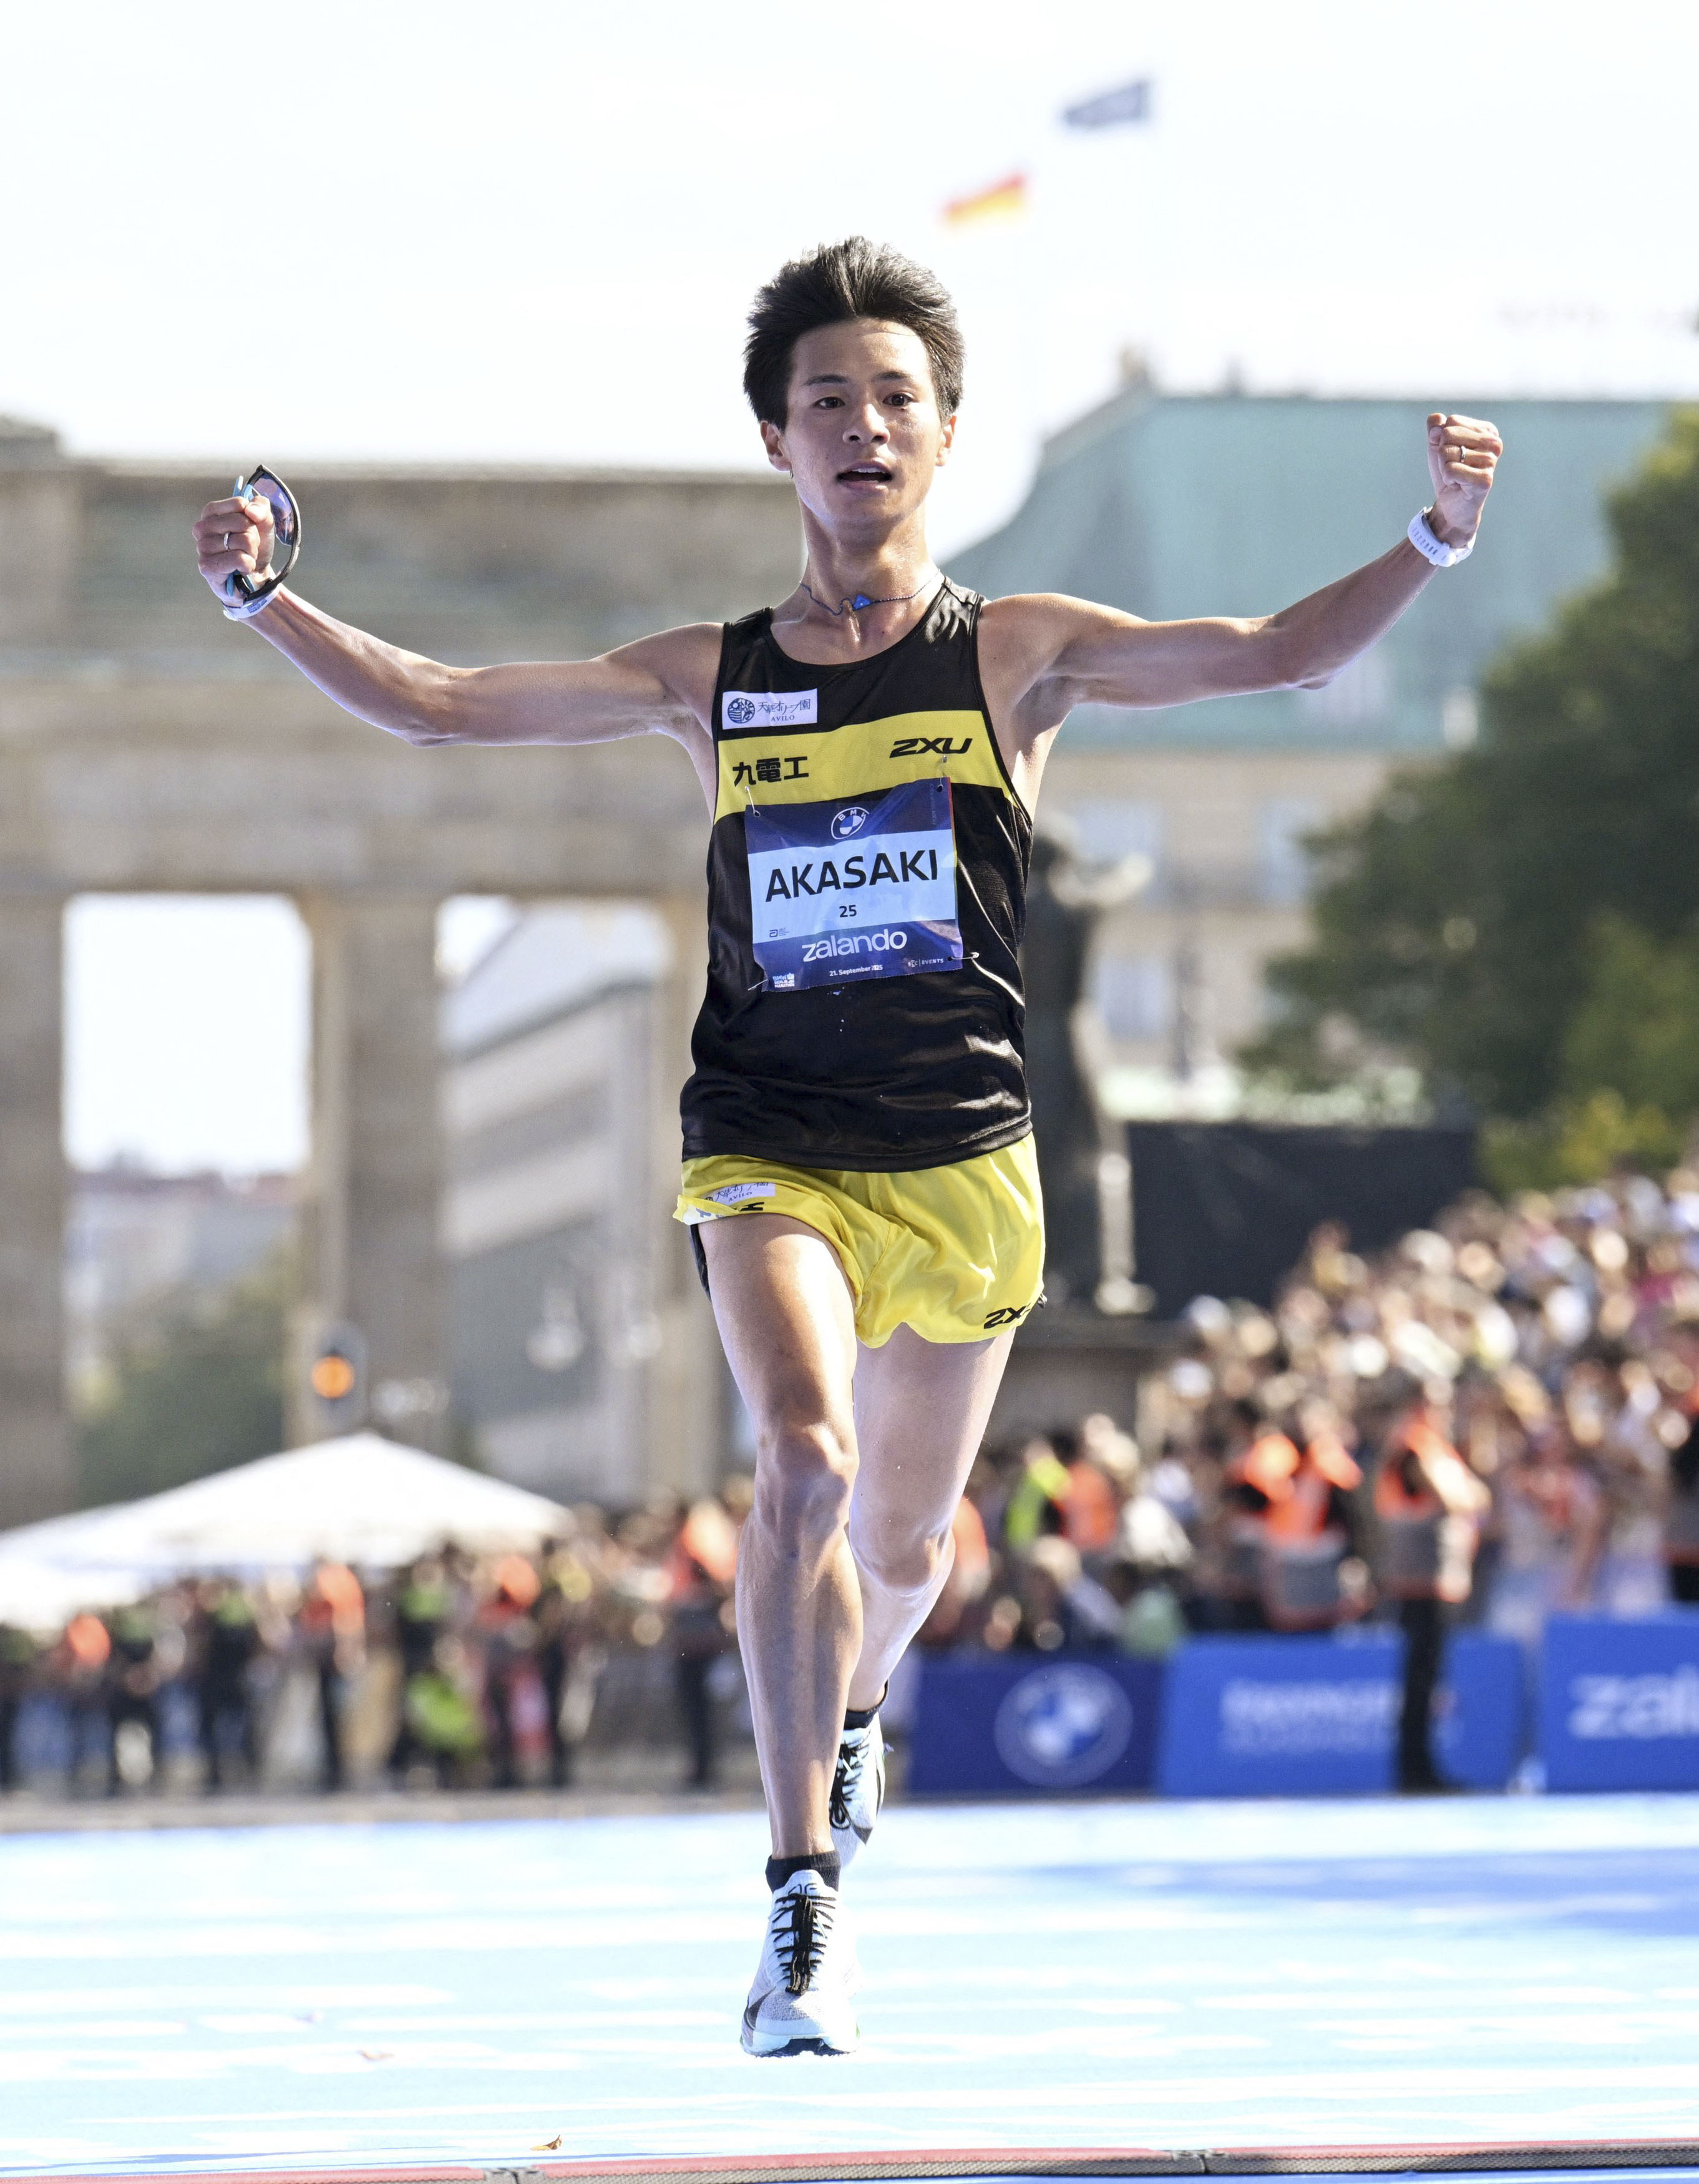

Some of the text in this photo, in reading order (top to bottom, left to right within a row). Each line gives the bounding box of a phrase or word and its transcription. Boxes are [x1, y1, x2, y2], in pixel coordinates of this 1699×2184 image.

[889, 737, 973, 759] 2XU
[733, 756, 809, 787] 九電工
[766, 849, 938, 903] AKASAKI
[839, 904, 858, 918] 25
[802, 929, 908, 963] zalando
[839, 967, 871, 976] September
